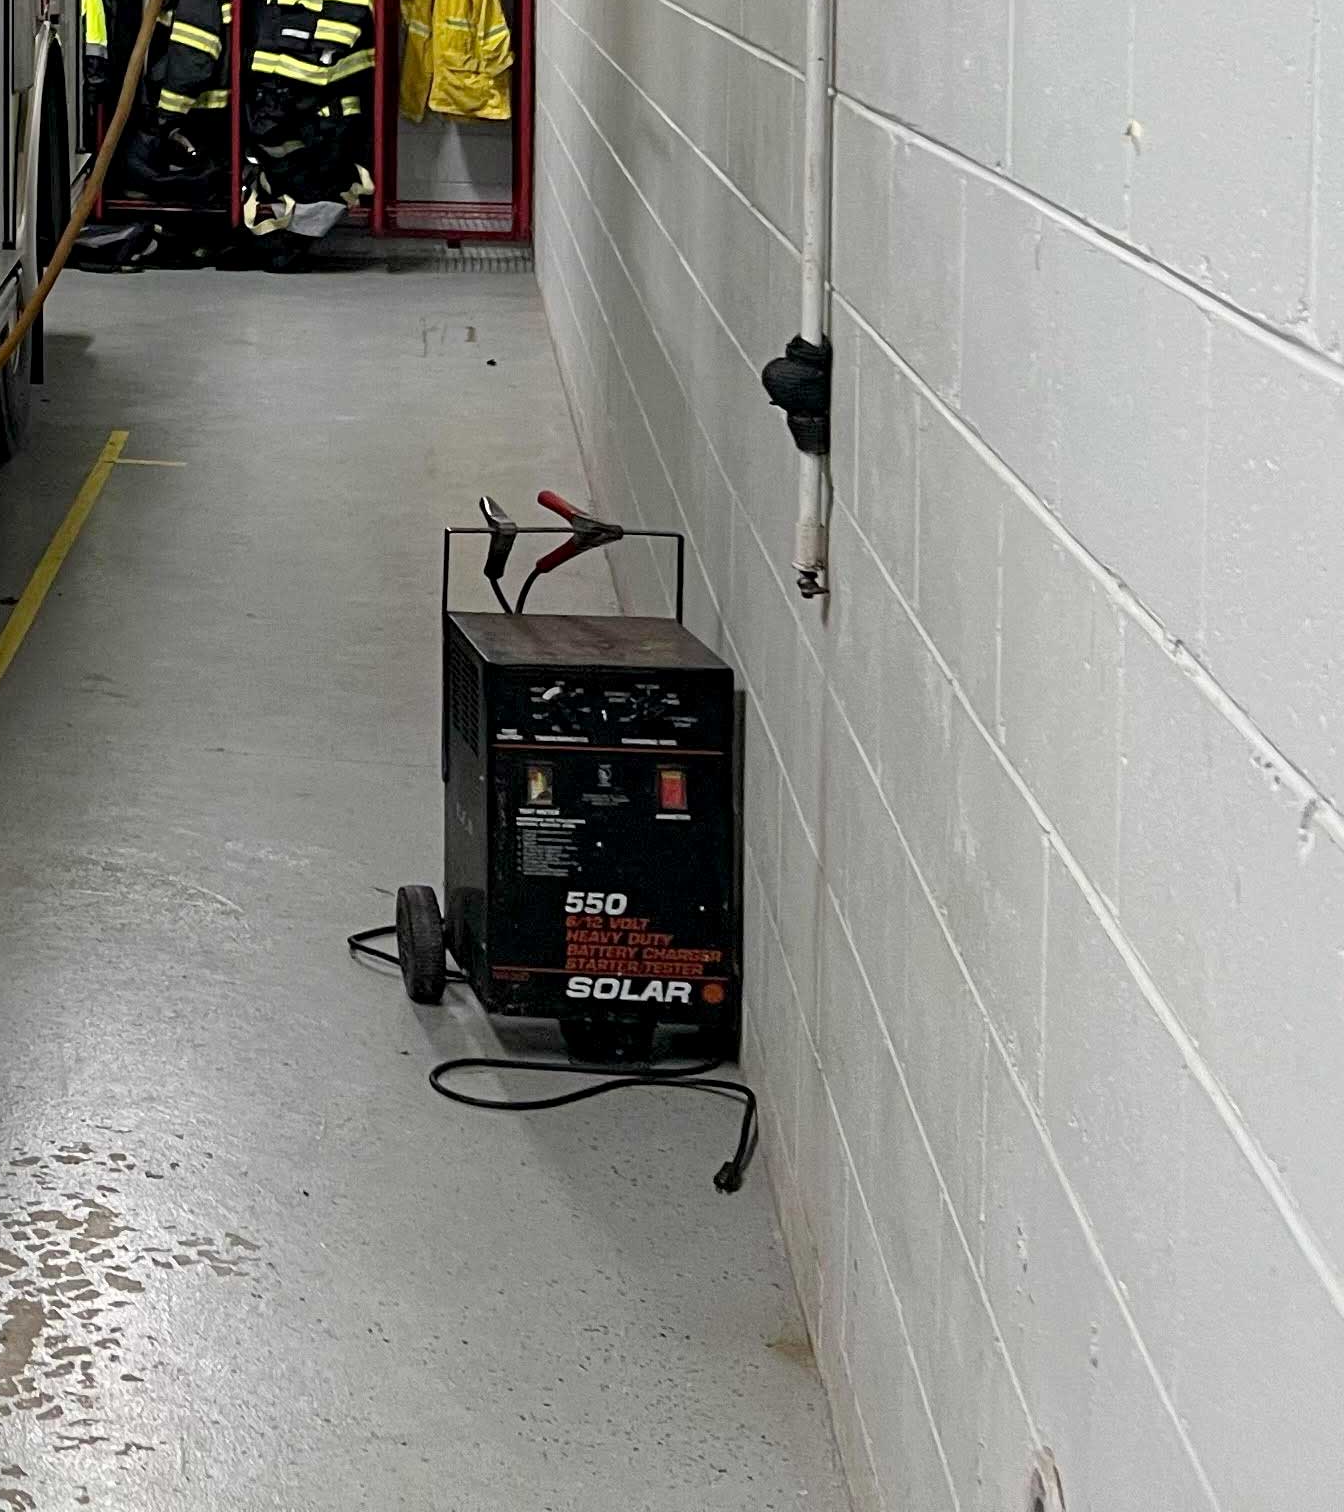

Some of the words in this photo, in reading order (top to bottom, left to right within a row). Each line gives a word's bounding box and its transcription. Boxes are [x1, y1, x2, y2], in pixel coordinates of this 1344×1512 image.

[565, 891, 627, 915] 550
[565, 916, 603, 928] 6/12
[610, 918, 650, 930] VOLT
[566, 930, 624, 944] HEAVY
[628, 933, 673, 946] DUTY
[566, 944, 639, 959] BATTERY
[642, 947, 721, 962] CHARGER
[565, 976, 692, 1004] SOLAR
